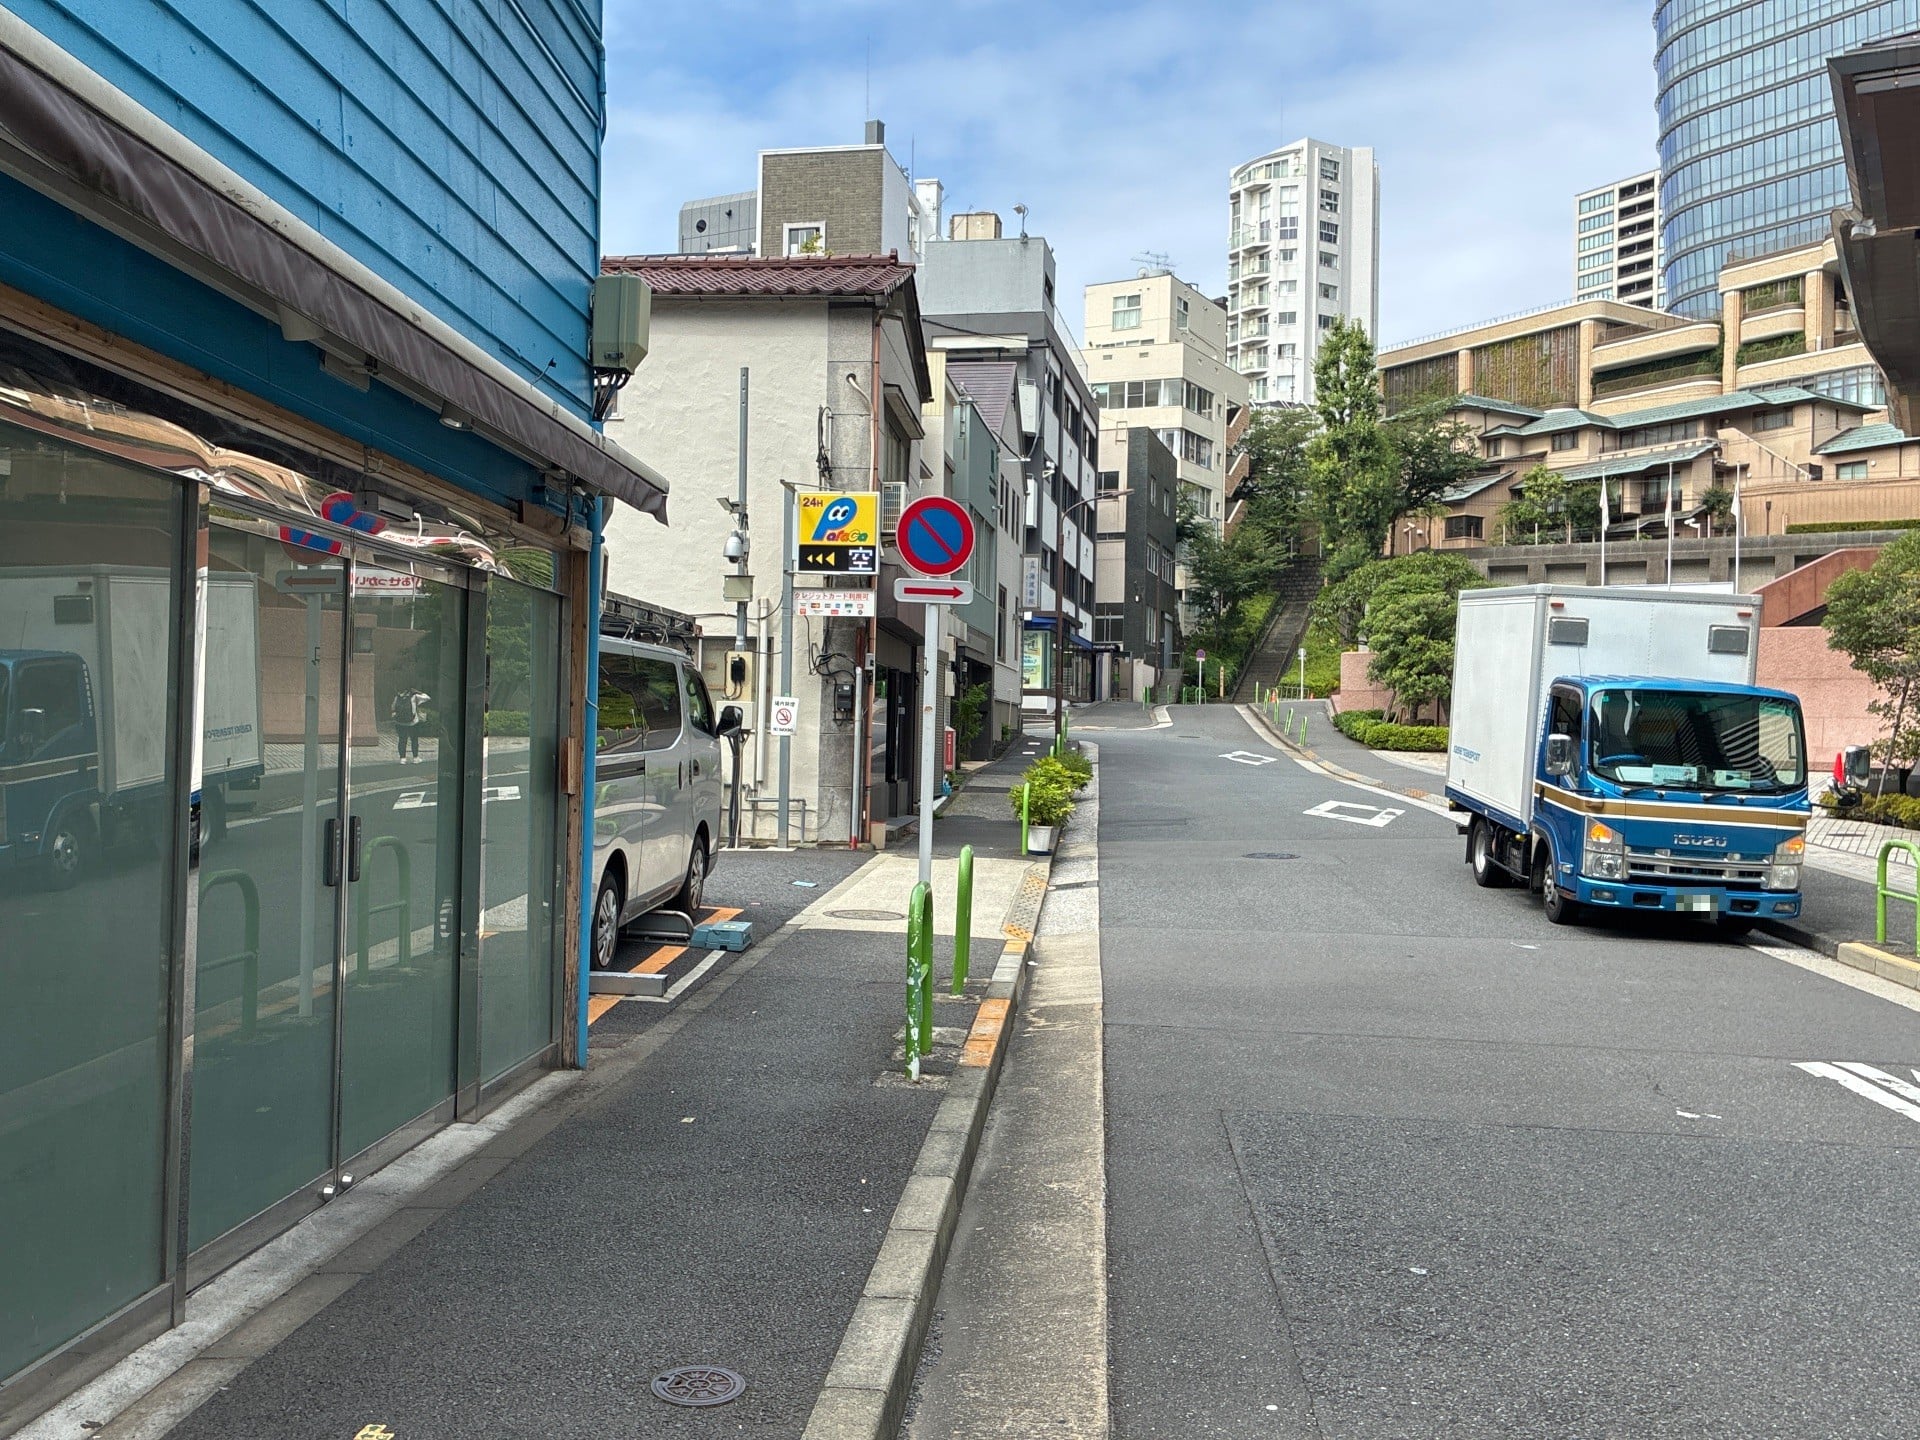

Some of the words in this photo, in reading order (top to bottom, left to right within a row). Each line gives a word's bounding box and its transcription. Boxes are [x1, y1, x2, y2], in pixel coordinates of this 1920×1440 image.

[802, 497, 823, 507] 24H
[848, 546, 873, 571] 空
[794, 591, 869, 601] クレジットカード利用可
[1673, 834, 1727, 847] ISUZU
